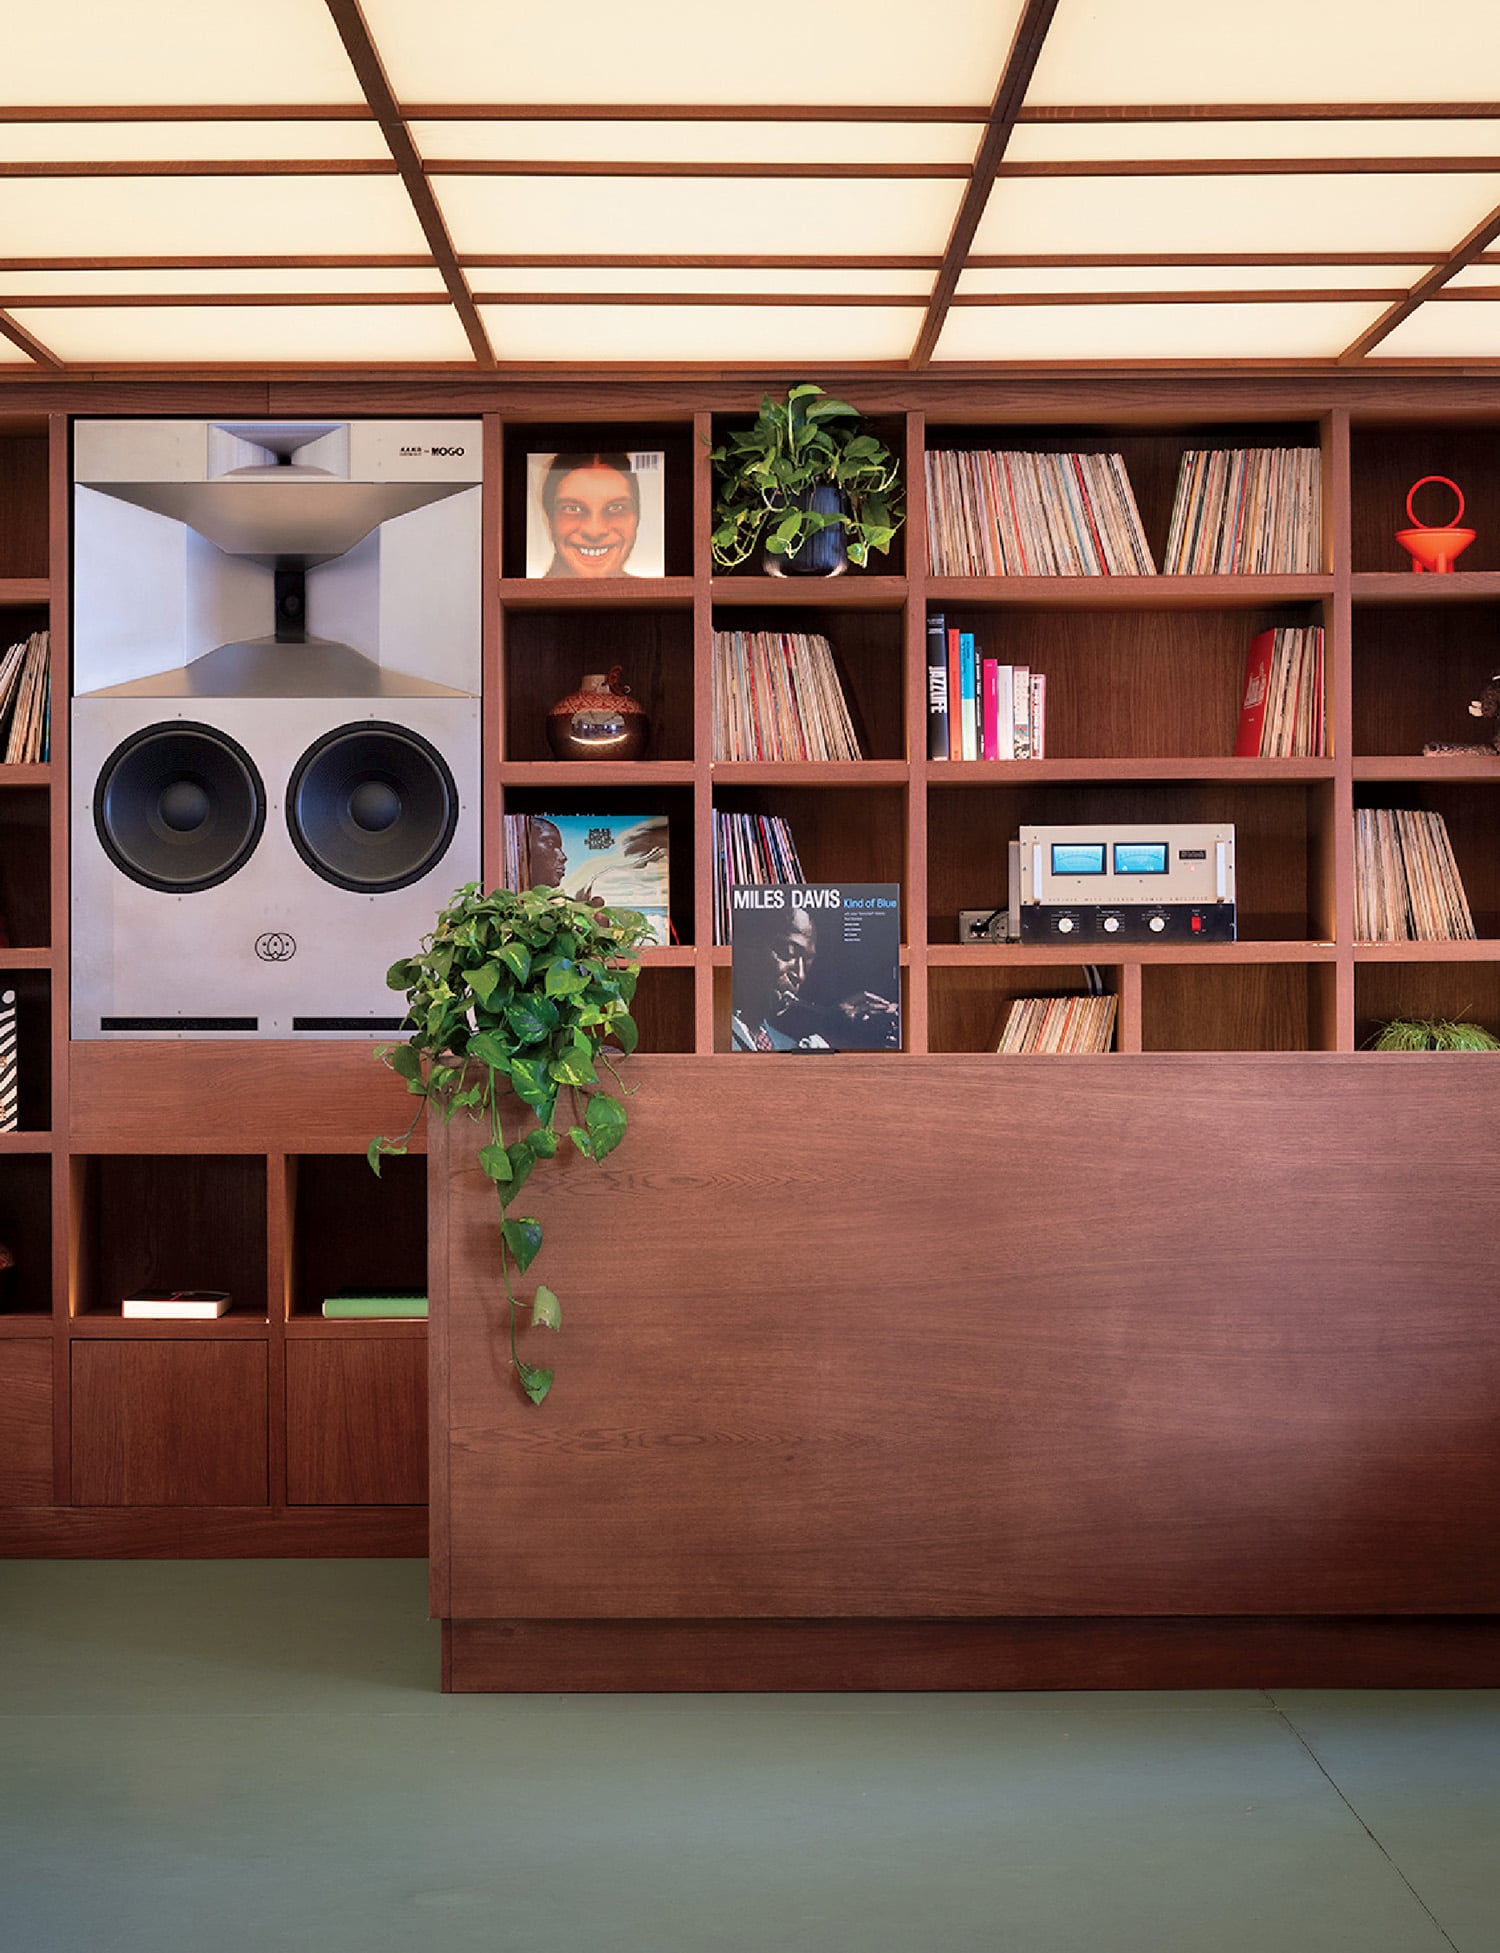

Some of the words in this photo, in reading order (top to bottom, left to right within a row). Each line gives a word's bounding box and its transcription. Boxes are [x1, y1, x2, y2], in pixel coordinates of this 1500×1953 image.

[431, 447, 464, 456] MOGO
[929, 666, 947, 713] JAZZLIFE
[734, 890, 785, 909] MILES
[791, 889, 841, 909] DAVIS
[843, 898, 864, 908] Kind
[865, 898, 876, 908] of
[876, 898, 897, 908] Blue
